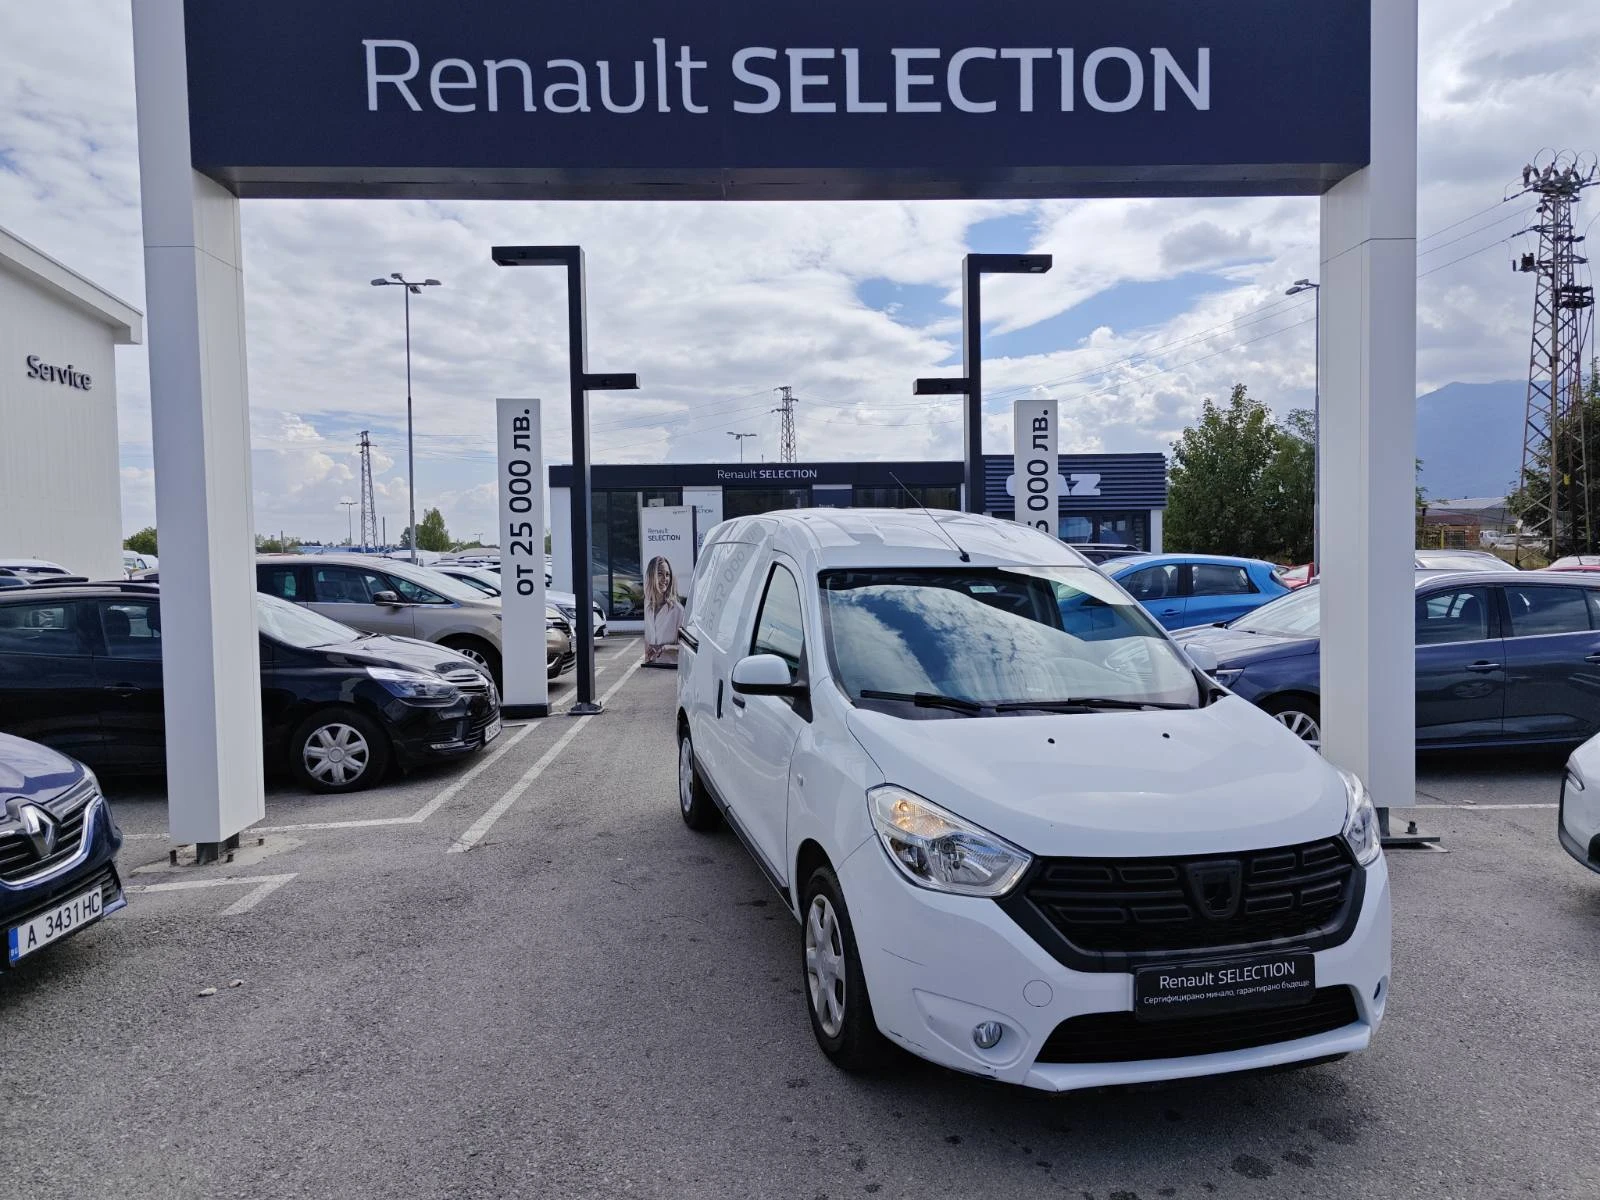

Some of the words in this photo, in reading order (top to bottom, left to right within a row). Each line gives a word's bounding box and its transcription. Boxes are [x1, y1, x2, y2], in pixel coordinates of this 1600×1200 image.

[361, 37, 709, 114] Renault
[732, 46, 1212, 114] SELECTION
[26, 354, 93, 391] Service
[513, 408, 531, 452] лв.
[1032, 409, 1049, 452] лв.
[508, 459, 532, 514] 000
[717, 469, 757, 479] Renault
[759, 469, 818, 479] SELECTION
[1026, 459, 1049, 512] 000
[509, 522, 533, 556] 25
[647, 534, 681, 542] SELECTION
[27, 924, 37, 948] A
[1159, 971, 1215, 990] Renault
[1218, 961, 1295, 985] SELECTION
[1143, 992, 1205, 1005] Сертифицирано
[1236, 983, 1281, 996] гарантирано
